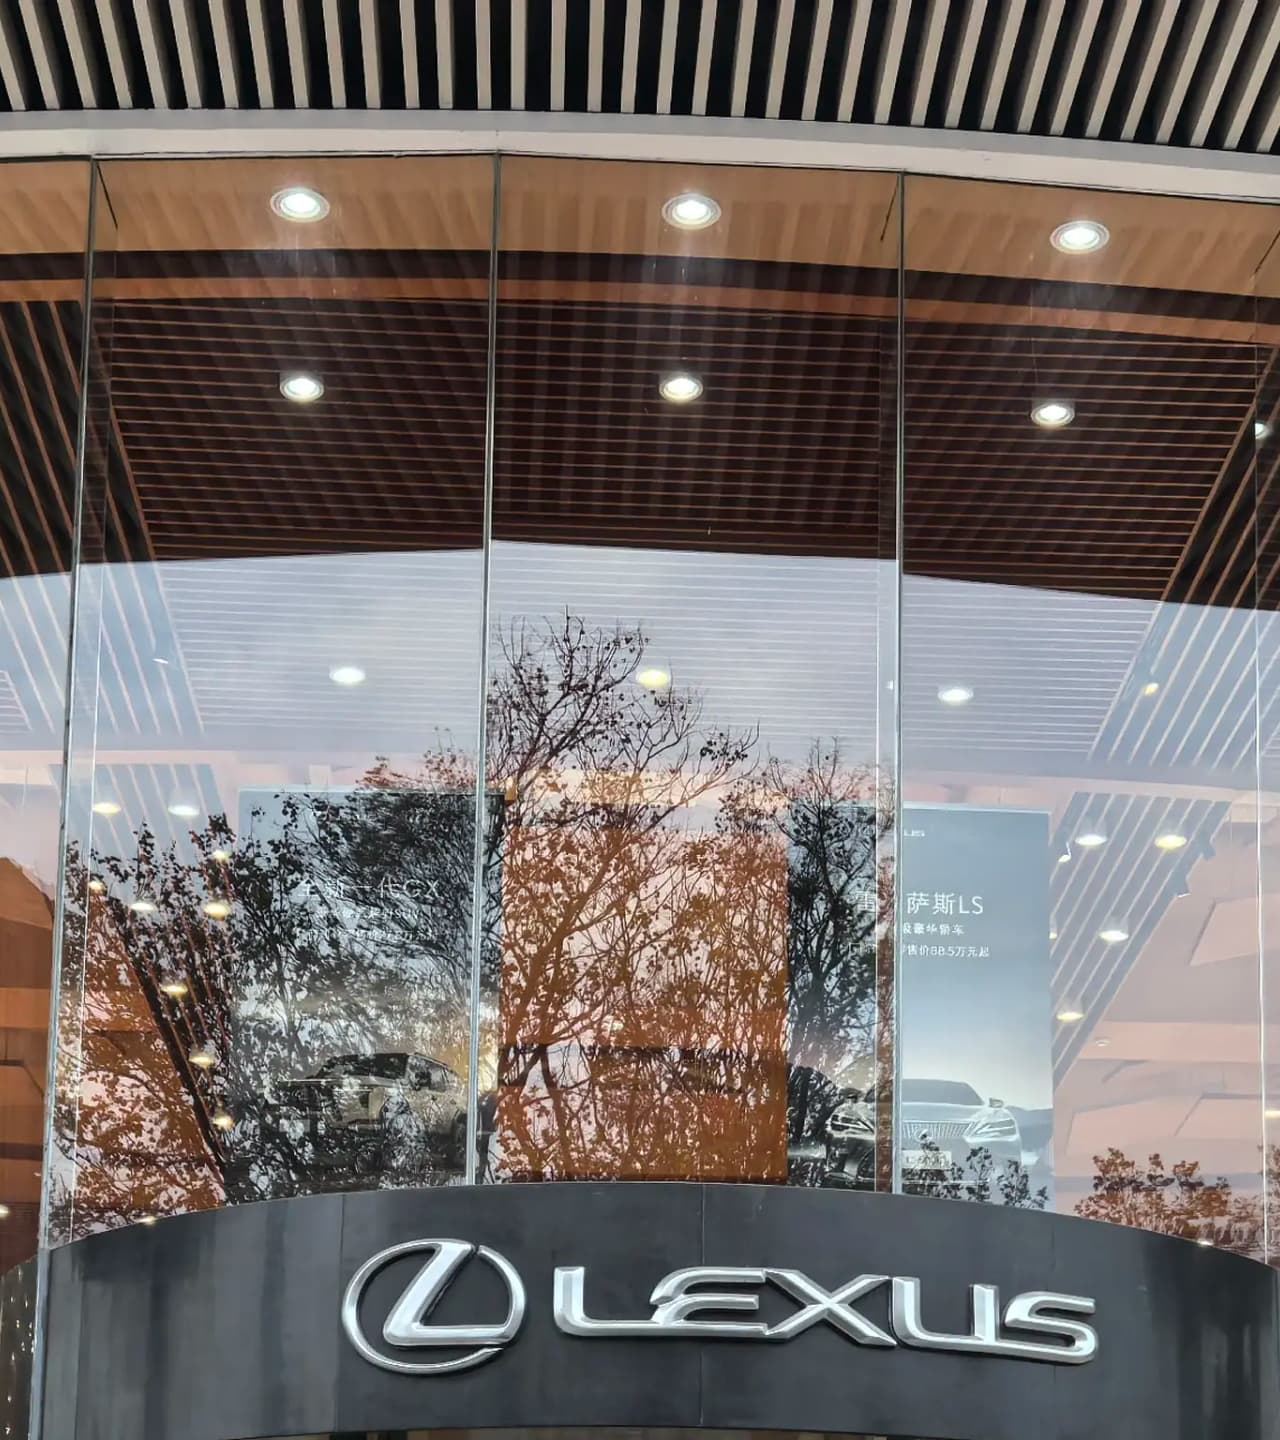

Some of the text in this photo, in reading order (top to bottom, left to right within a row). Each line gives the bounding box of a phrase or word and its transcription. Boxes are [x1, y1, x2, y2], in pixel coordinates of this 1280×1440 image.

[854, 889, 984, 916] 雷萨斯LS
[553, 1265, 1097, 1365] LEXUS
